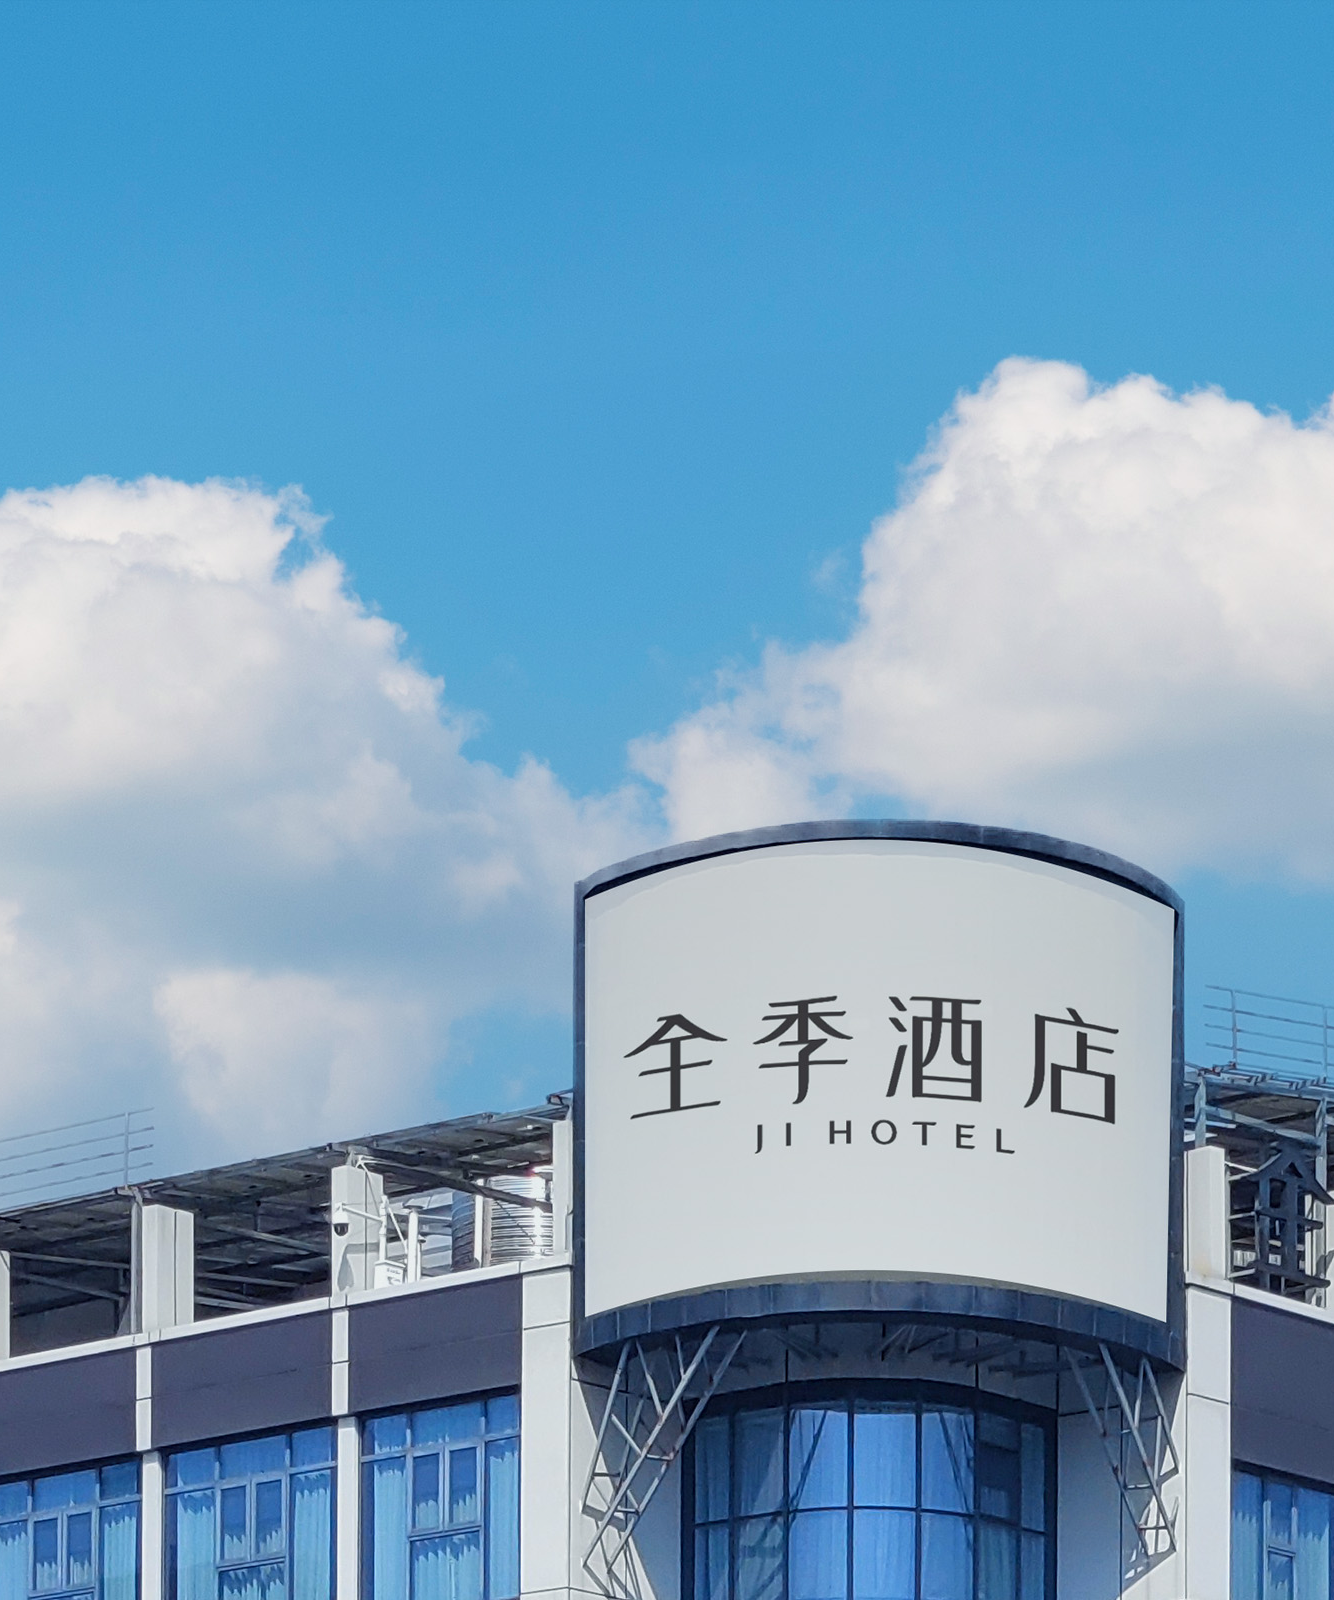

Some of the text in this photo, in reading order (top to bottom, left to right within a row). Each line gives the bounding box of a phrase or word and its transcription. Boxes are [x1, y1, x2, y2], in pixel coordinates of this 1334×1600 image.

[623, 994, 1119, 1125] 全季酒店
[754, 1118, 1016, 1155] JI HOTEL
